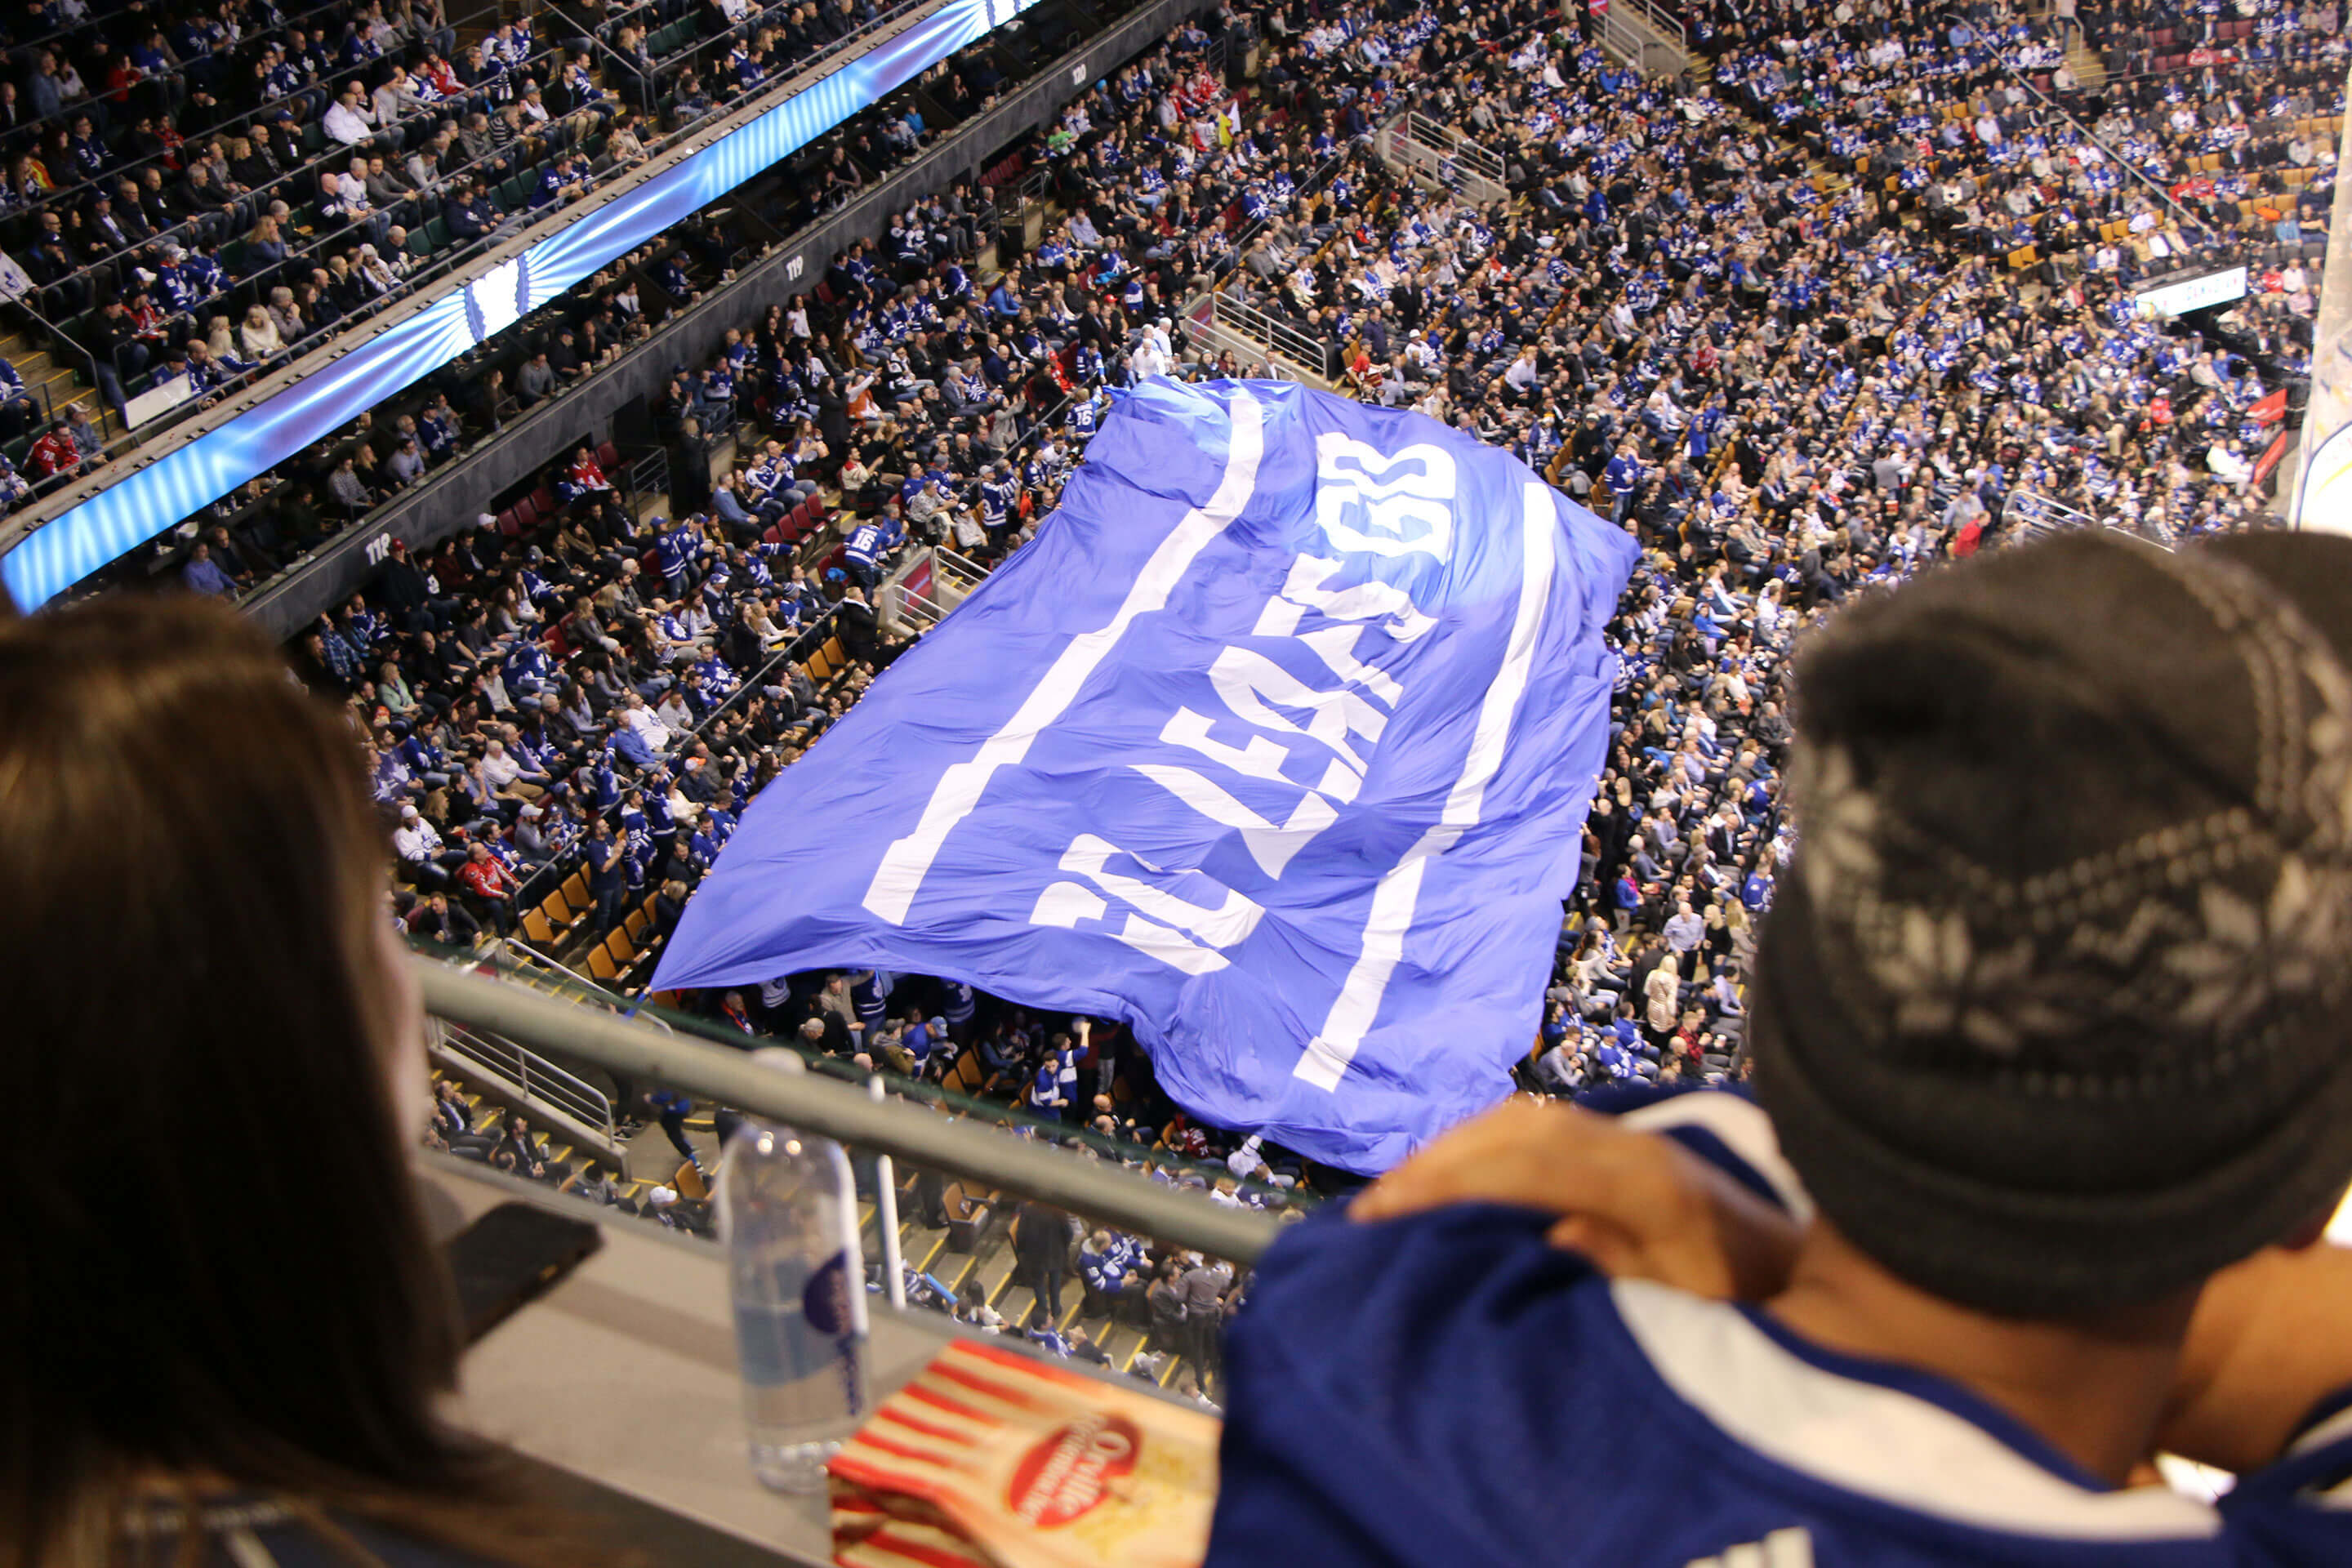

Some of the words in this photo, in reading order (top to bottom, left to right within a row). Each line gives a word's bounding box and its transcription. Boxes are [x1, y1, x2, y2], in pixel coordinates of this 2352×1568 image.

[786, 256, 804, 282] 119
[1315, 431, 1456, 567] GO
[365, 532, 391, 566] 118
[851, 532, 876, 552] 16
